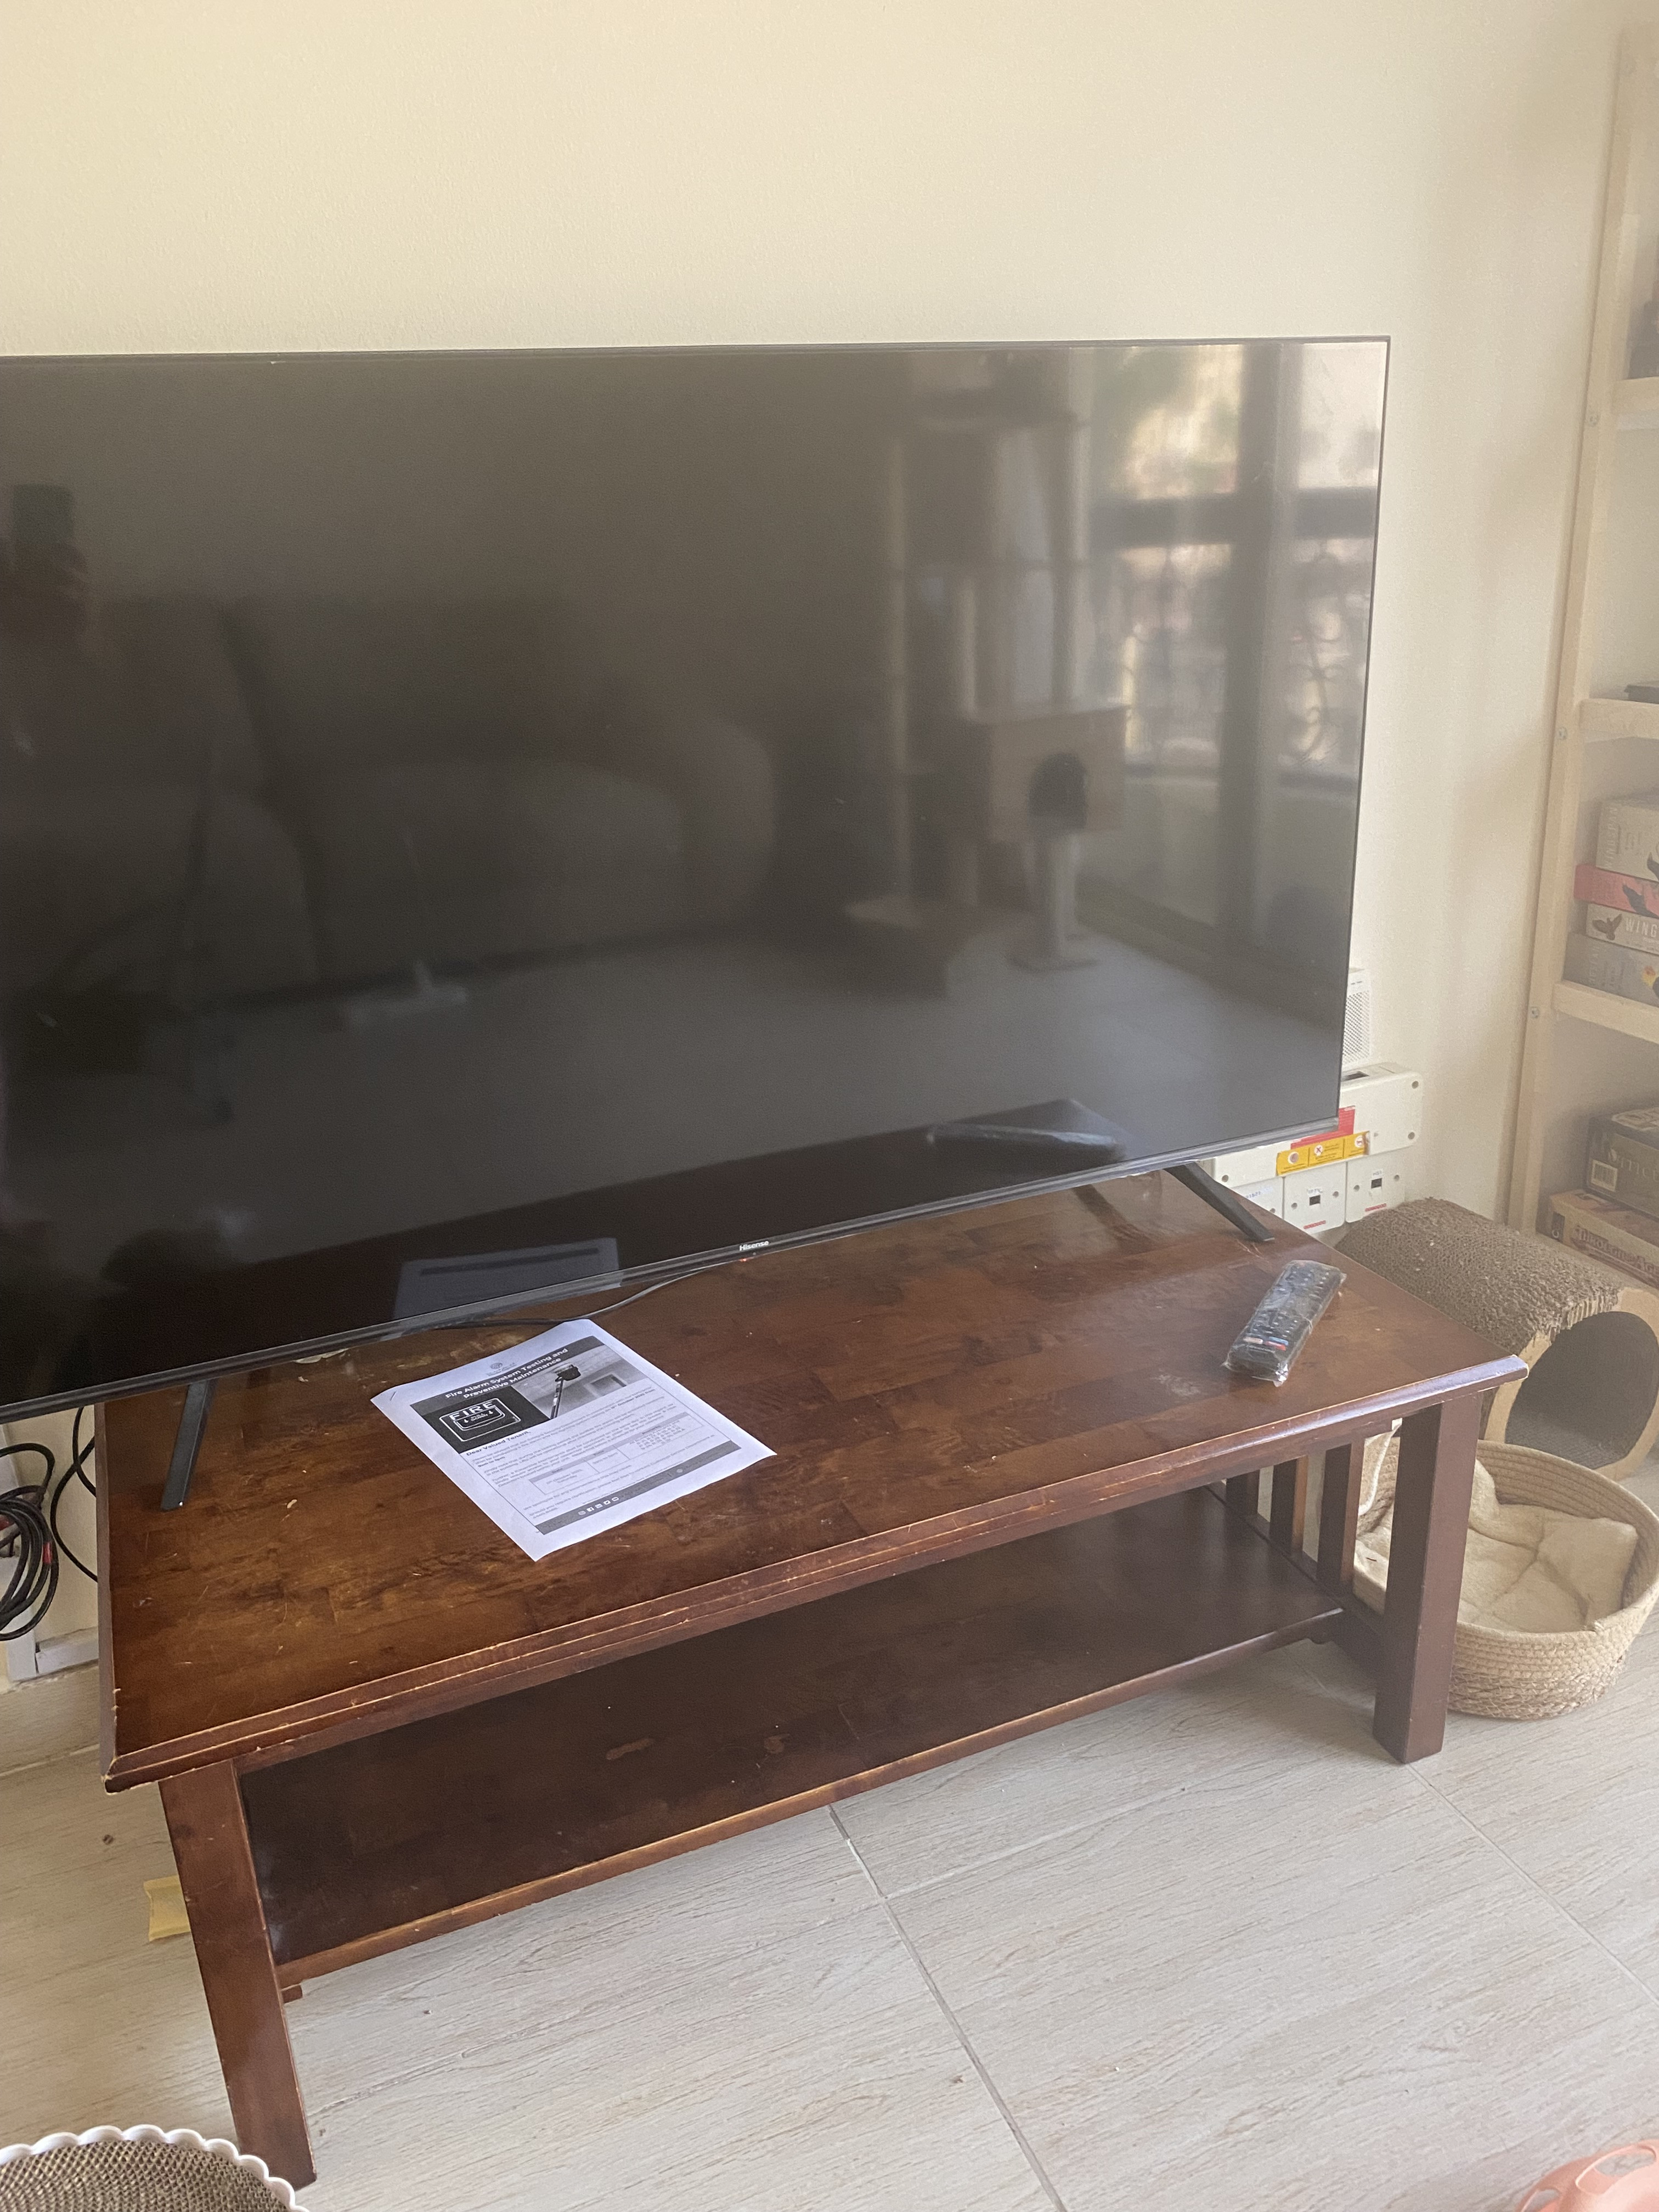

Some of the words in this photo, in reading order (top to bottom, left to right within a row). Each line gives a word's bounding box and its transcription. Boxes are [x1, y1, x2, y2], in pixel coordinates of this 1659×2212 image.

[1626, 917, 1658, 938] WING
[739, 1240, 769, 1251] Hisense
[445, 1390, 463, 1398] Fire
[465, 1382, 489, 1393] Alarm
[490, 1370, 521, 1384] System
[521, 1356, 552, 1371] Testing
[552, 1348, 568, 1357] and
[463, 1381, 509, 1399] Preventive
[509, 1357, 562, 1384] Maintenance
[449, 1401, 495, 1420] FIRE
[483, 1440, 506, 1451] Valued
[507, 1430, 532, 1442] Tenant,
